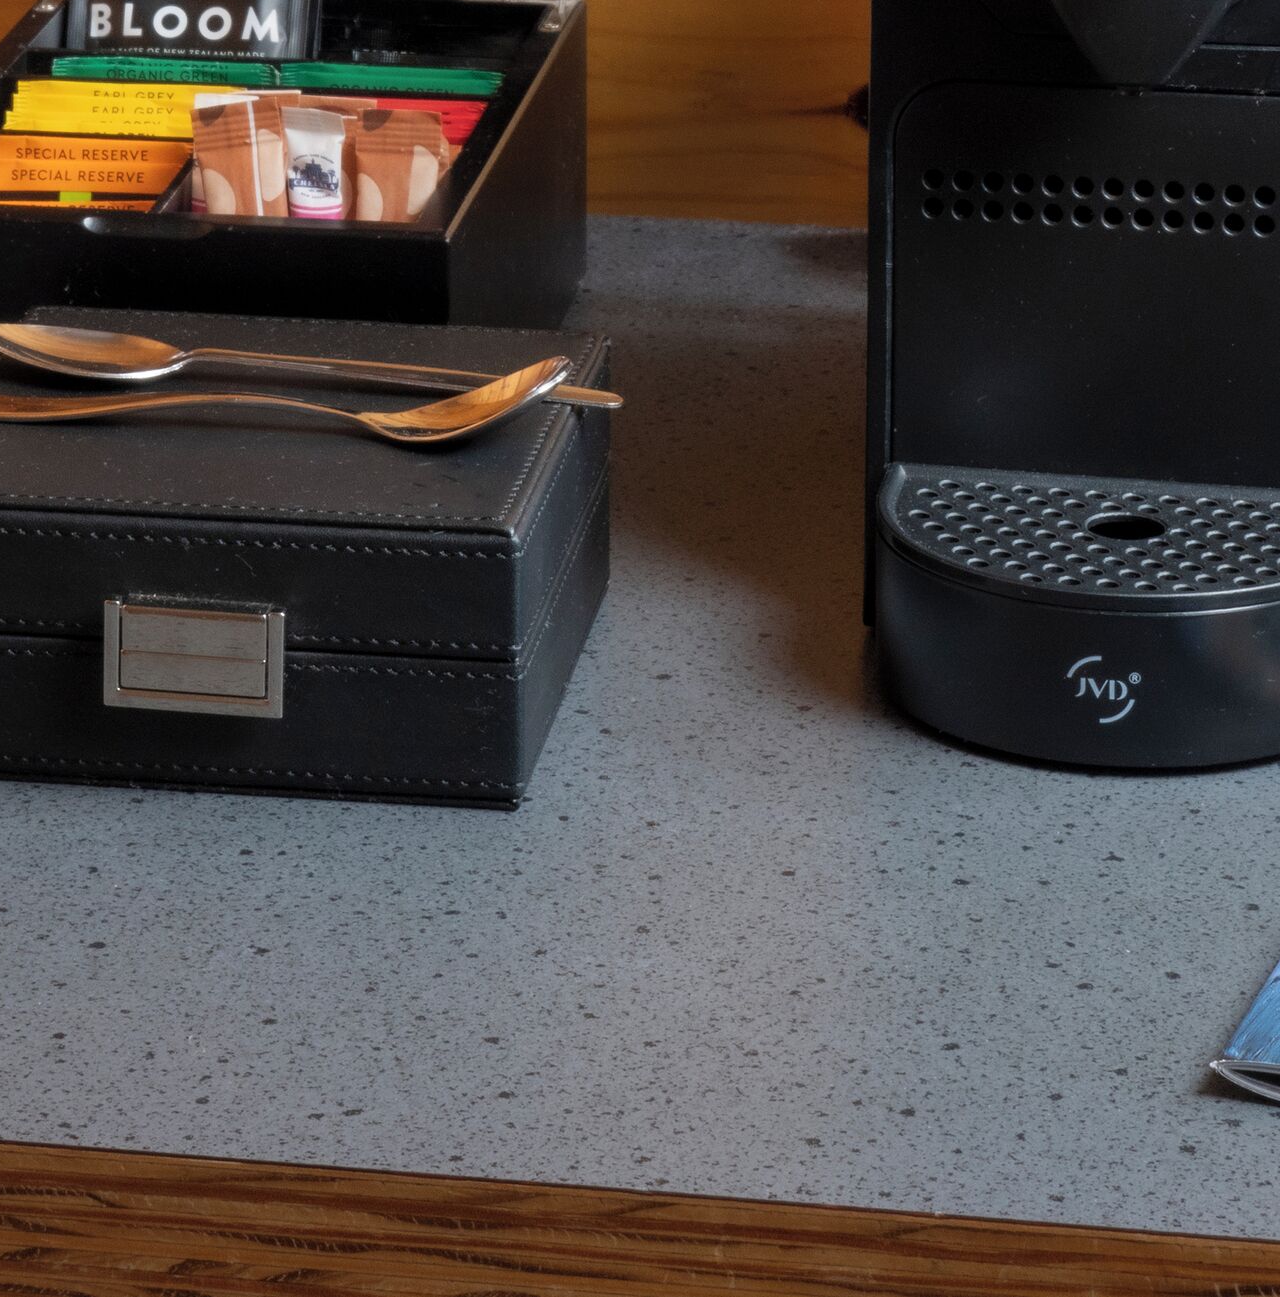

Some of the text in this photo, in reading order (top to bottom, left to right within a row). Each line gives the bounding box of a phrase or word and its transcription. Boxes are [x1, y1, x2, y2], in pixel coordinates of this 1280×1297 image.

[89, 3, 280, 43] BLOOM
[106, 69, 229, 82] ORGANIC GREEN
[16, 148, 150, 162] SPECIAL RESERVE
[11, 170, 146, 184] SPECIAL RESERVE
[1074, 677, 1129, 701] JVD
